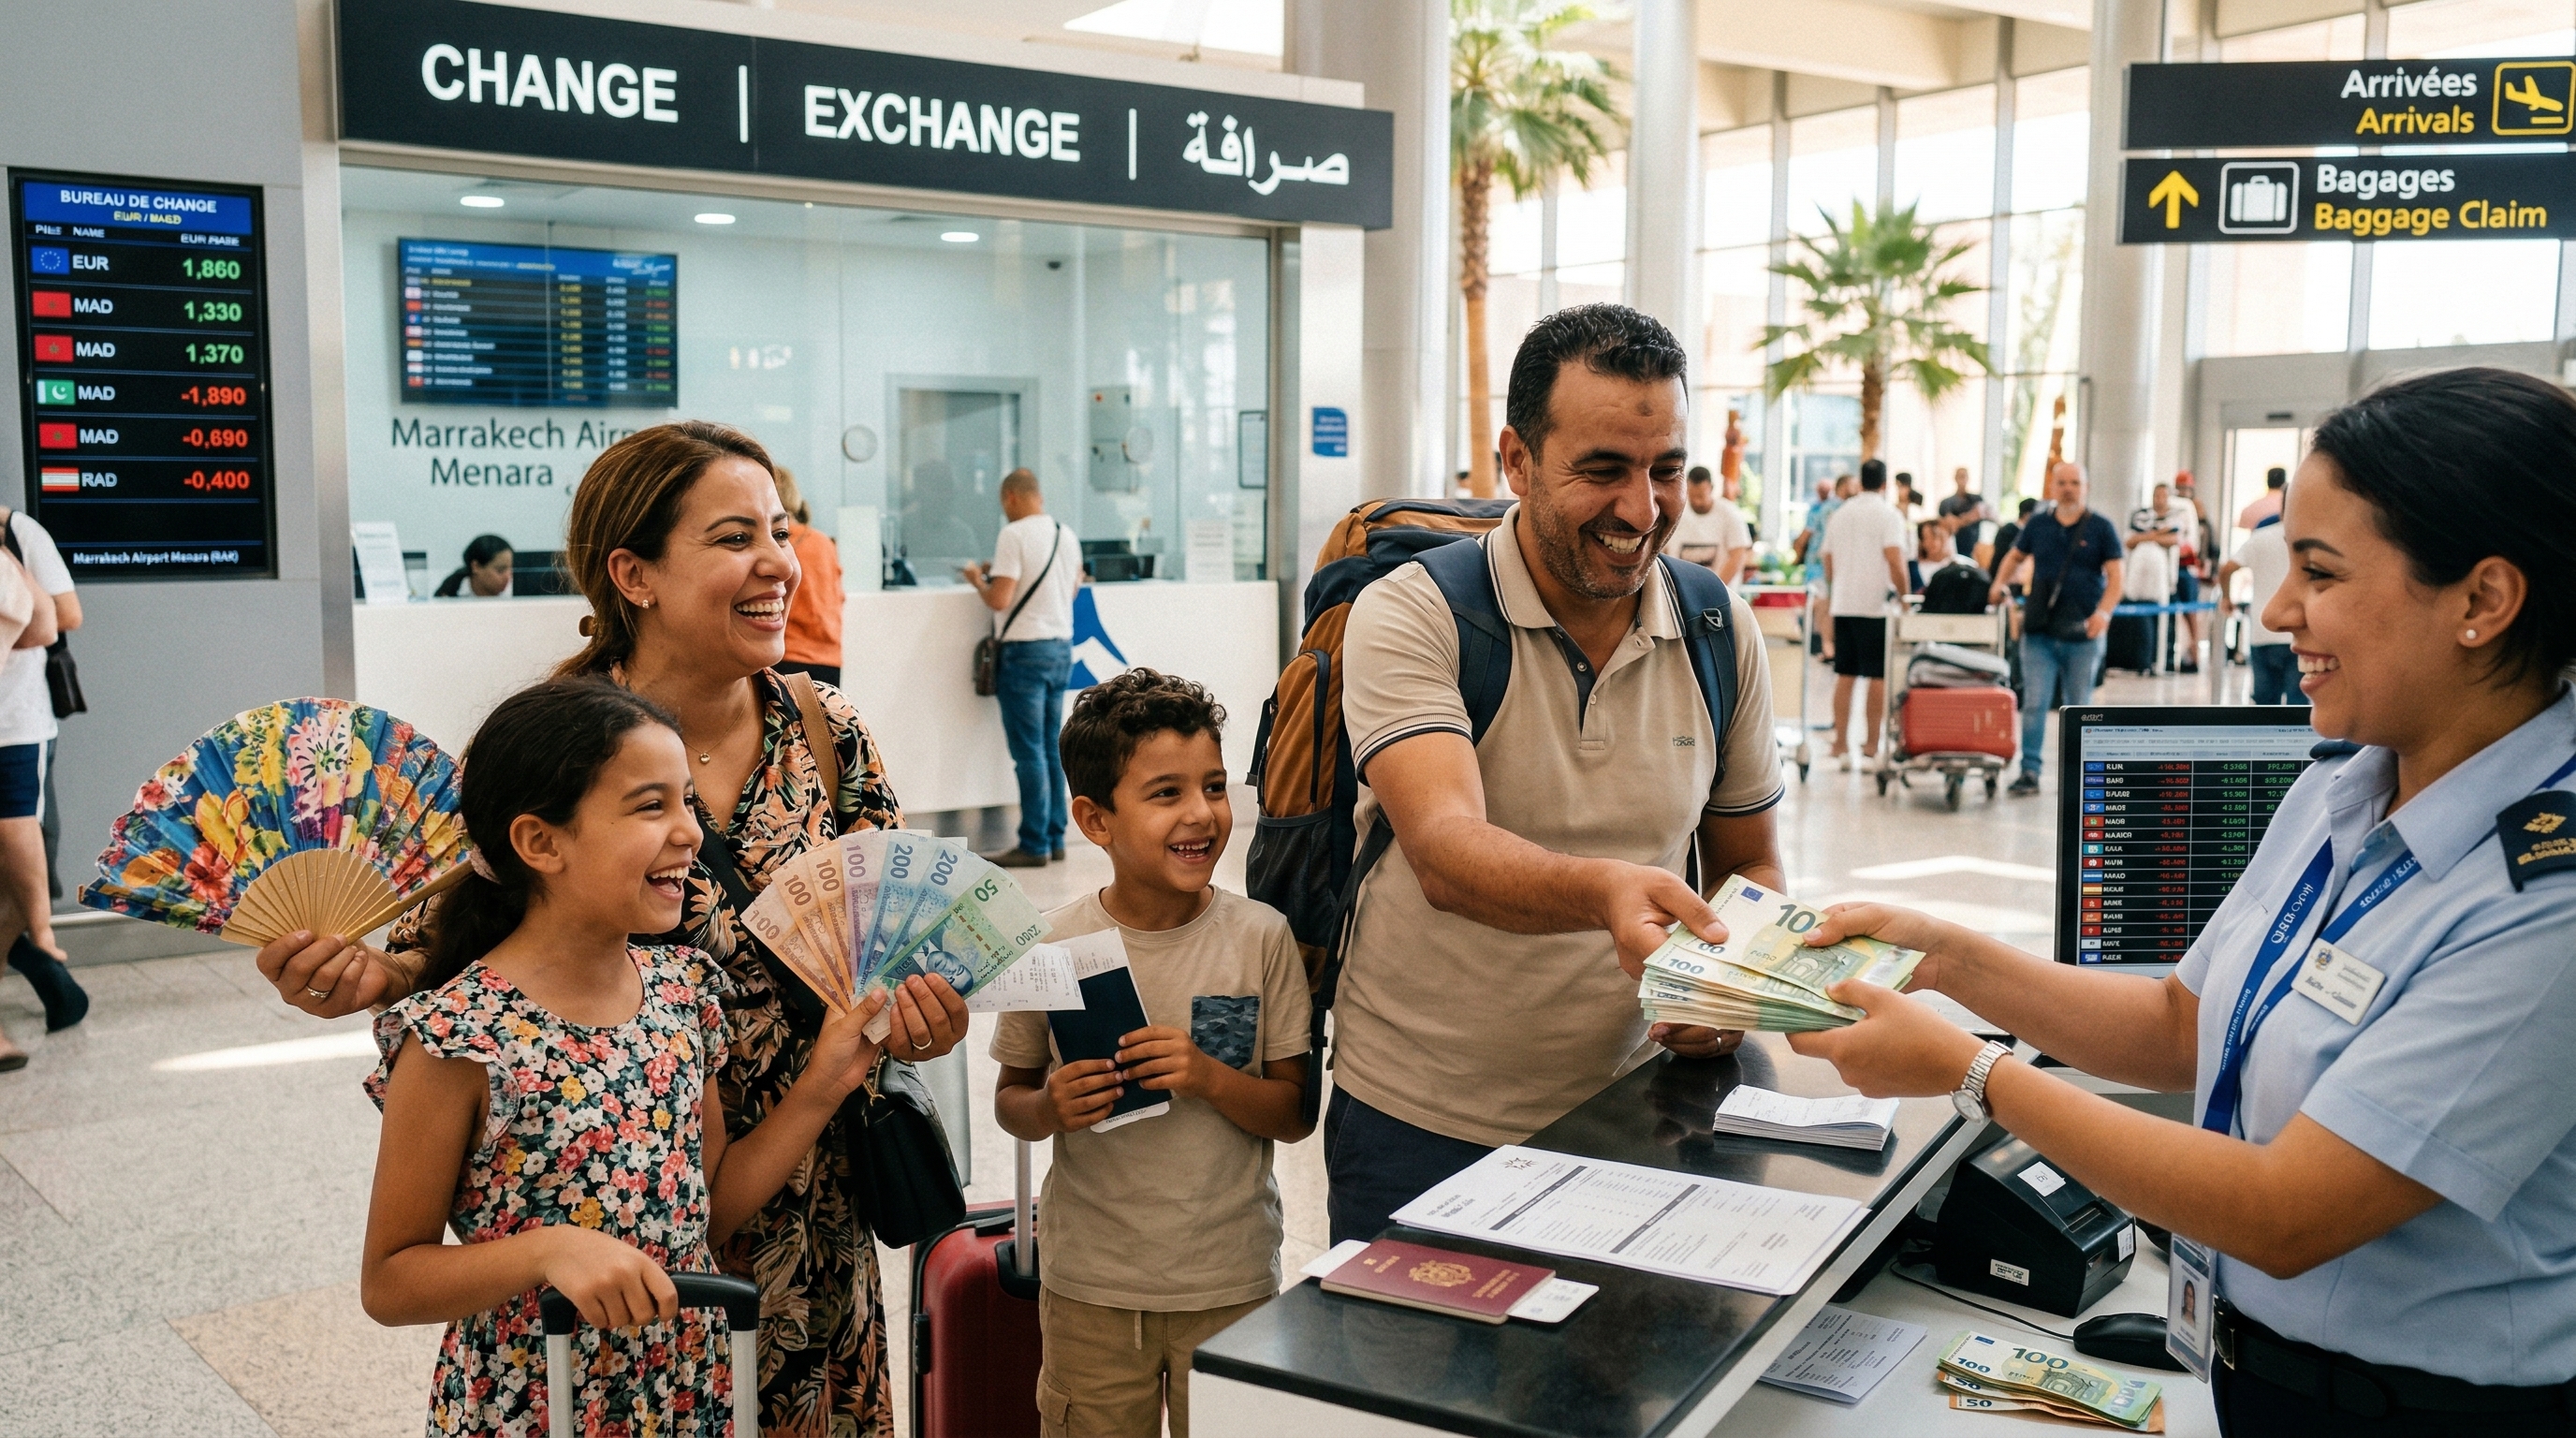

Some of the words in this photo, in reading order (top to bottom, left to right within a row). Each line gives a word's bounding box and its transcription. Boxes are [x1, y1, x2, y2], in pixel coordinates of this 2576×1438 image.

[421, 43, 679, 124] CHANGE
[2340, 66, 2478, 99] Arrivées
[804, 84, 1081, 163] EXCHANGE
[2355, 105, 2475, 135] Arrivals
[1182, 110, 1350, 196] صرافة
[2317, 164, 2455, 200] Bagages
[60, 189, 125, 207] BUREAU
[128, 194, 151, 209] DE
[153, 196, 217, 213] CHANGE
[2314, 202, 2451, 236] Baggage
[2459, 199, 2547, 228] Claim
[72, 254, 110, 271] EUR
[183, 258, 241, 280] 1,860
[74, 297, 113, 315] MAD
[184, 301, 242, 323] 1,330
[76, 341, 116, 358] MAD
[185, 344, 244, 364] 1,370
[78, 385, 116, 401] MAD
[181, 386, 246, 406] -1,890
[80, 428, 119, 445] MAD
[183, 428, 248, 448] -0,690
[391, 416, 565, 449] Marrakech
[81, 472, 117, 488] RAD
[183, 470, 250, 491] -0,400
[431, 457, 553, 487] Menara
[846, 844, 867, 878] 100
[889, 844, 914, 879] 200
[929, 849, 959, 887] 200
[815, 858, 841, 892] 100
[783, 873, 812, 906] 100
[973, 878, 999, 902] 50
[749, 909, 781, 941] 100
[1775, 903, 1824, 934] 10
[1668, 958, 1705, 975] 100
[1956, 1357, 1991, 1373] 100
[2012, 1346, 2070, 1370] 100
[1966, 1399, 1993, 1408] 50
